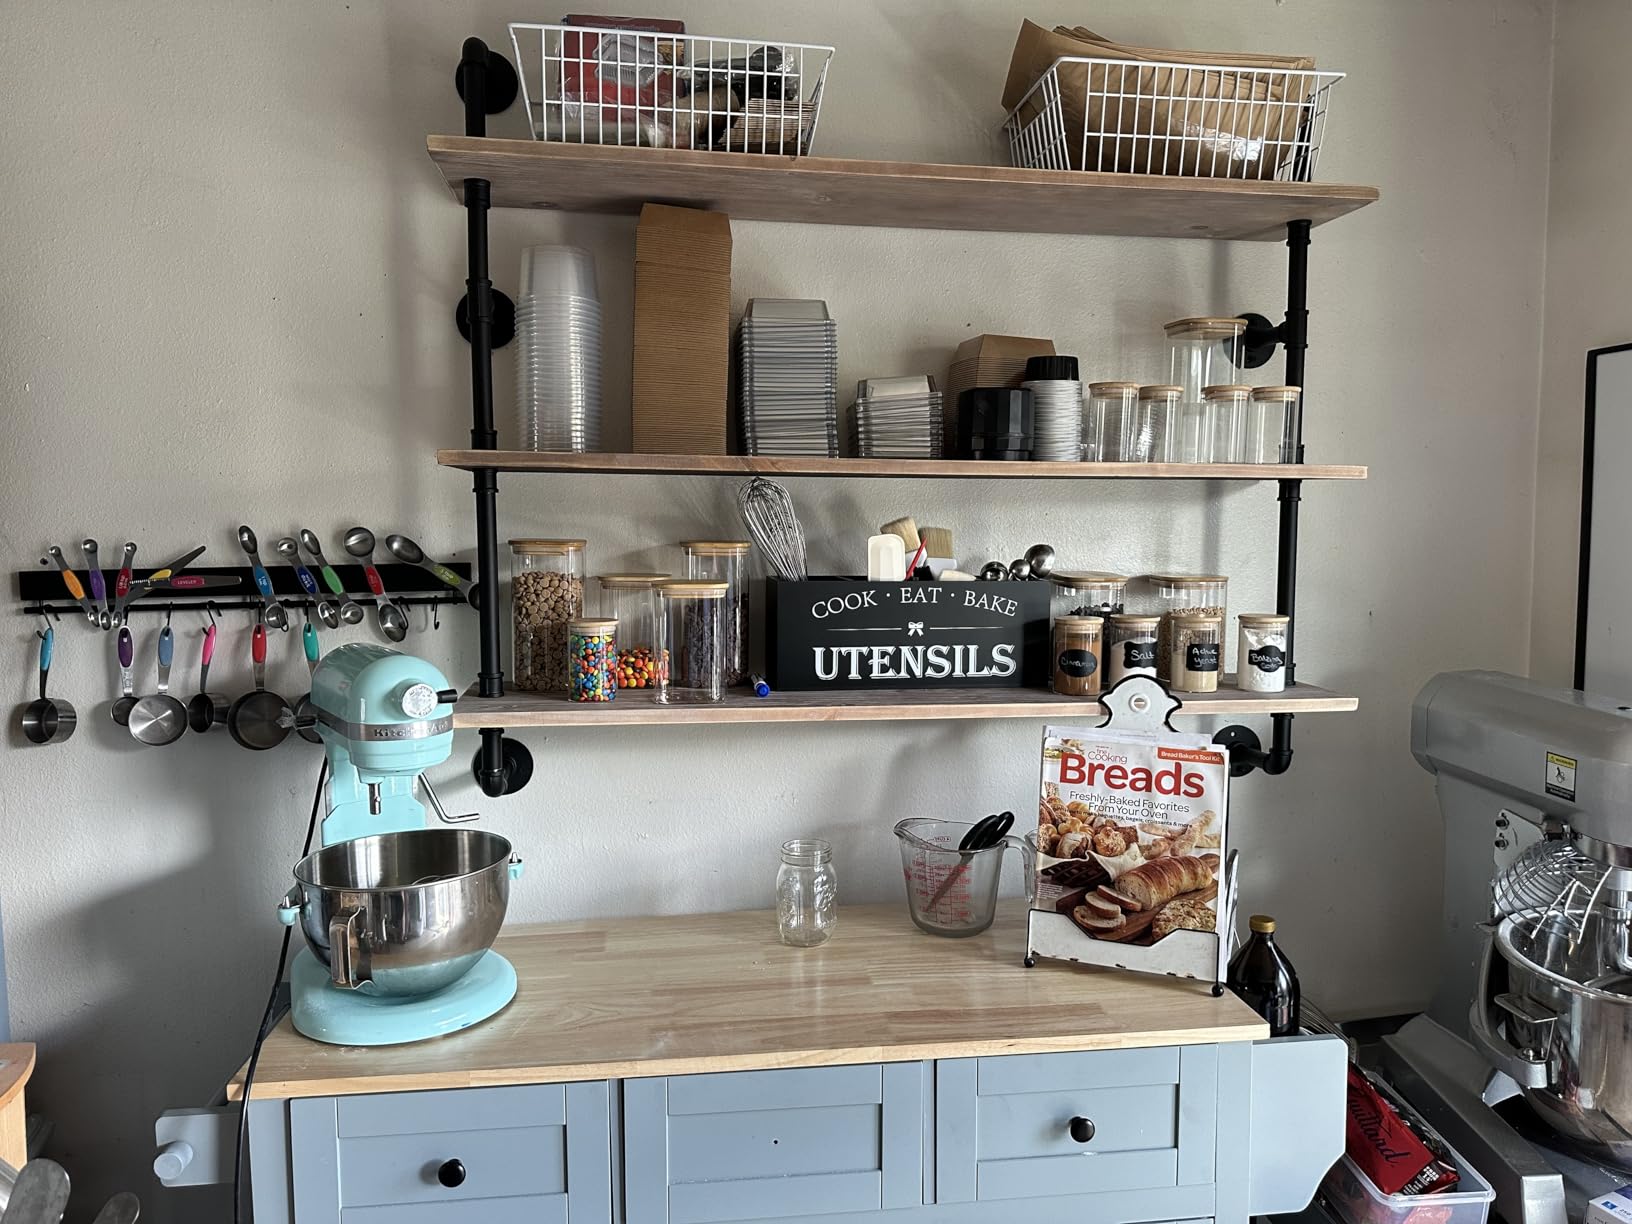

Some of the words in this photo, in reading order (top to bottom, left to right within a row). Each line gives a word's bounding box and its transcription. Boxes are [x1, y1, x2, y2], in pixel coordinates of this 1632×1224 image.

[811, 589, 878, 619] COOK
[900, 587, 942, 604] EAT
[964, 590, 1018, 617] BAKE
[812, 644, 1017, 681] UTENSILS
[1130, 649, 1155, 661] Salt
[1250, 653, 1283, 665] Baking
[374, 720, 449, 737] KitchAid
[1088, 751, 1128, 764] Cooking
[1179, 752, 1199, 760] Baker's
[1060, 752, 1205, 798] Breads
[1070, 791, 1141, 807] Freshly-Baked
[1142, 799, 1190, 812] Favorites
[1088, 802, 1115, 813] From
[1116, 805, 1139, 815] Your
[1140, 808, 1168, 819] Oven
[1145, 818, 1172, 826] croissants
